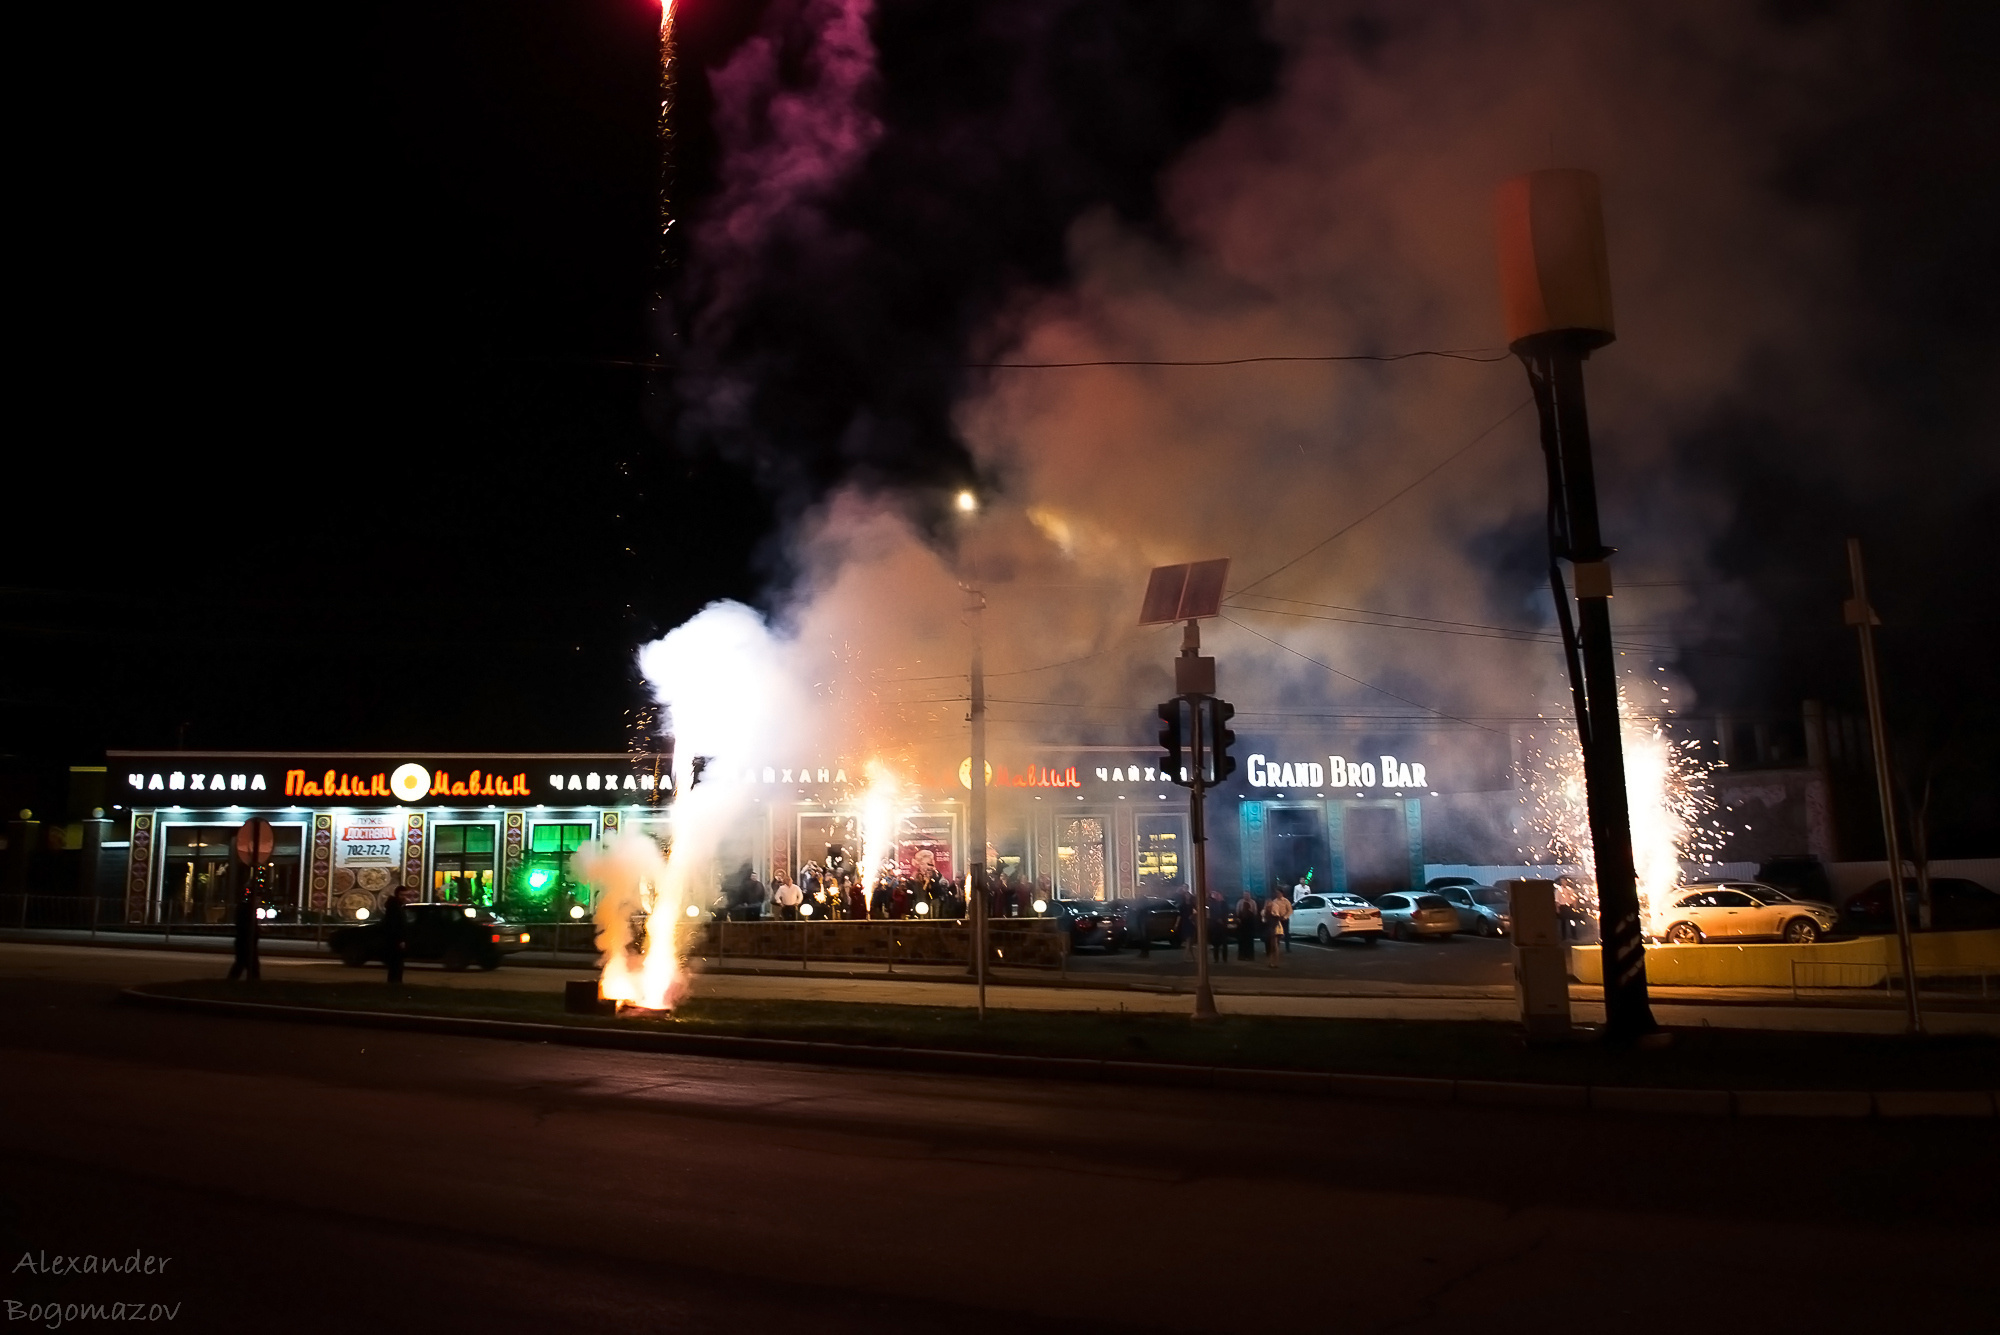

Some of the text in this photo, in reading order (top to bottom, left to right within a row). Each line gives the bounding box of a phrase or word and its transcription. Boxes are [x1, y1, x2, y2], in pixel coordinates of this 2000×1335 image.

[128, 770, 267, 791] ЧАЙХАНА
[549, 771, 673, 791] ЧАЙХАНА
[741, 766, 849, 783] АЙХАНА
[996, 763, 1082, 788] Мавлин
[1095, 765, 1194, 782] ЧАЙХАН
[1380, 756, 1428, 788] BAR
[285, 769, 531, 797] Павлин Мавлин
[346, 827, 392, 838] ДОСТАВКИ
[347, 844, 390, 855] 702-72-72
